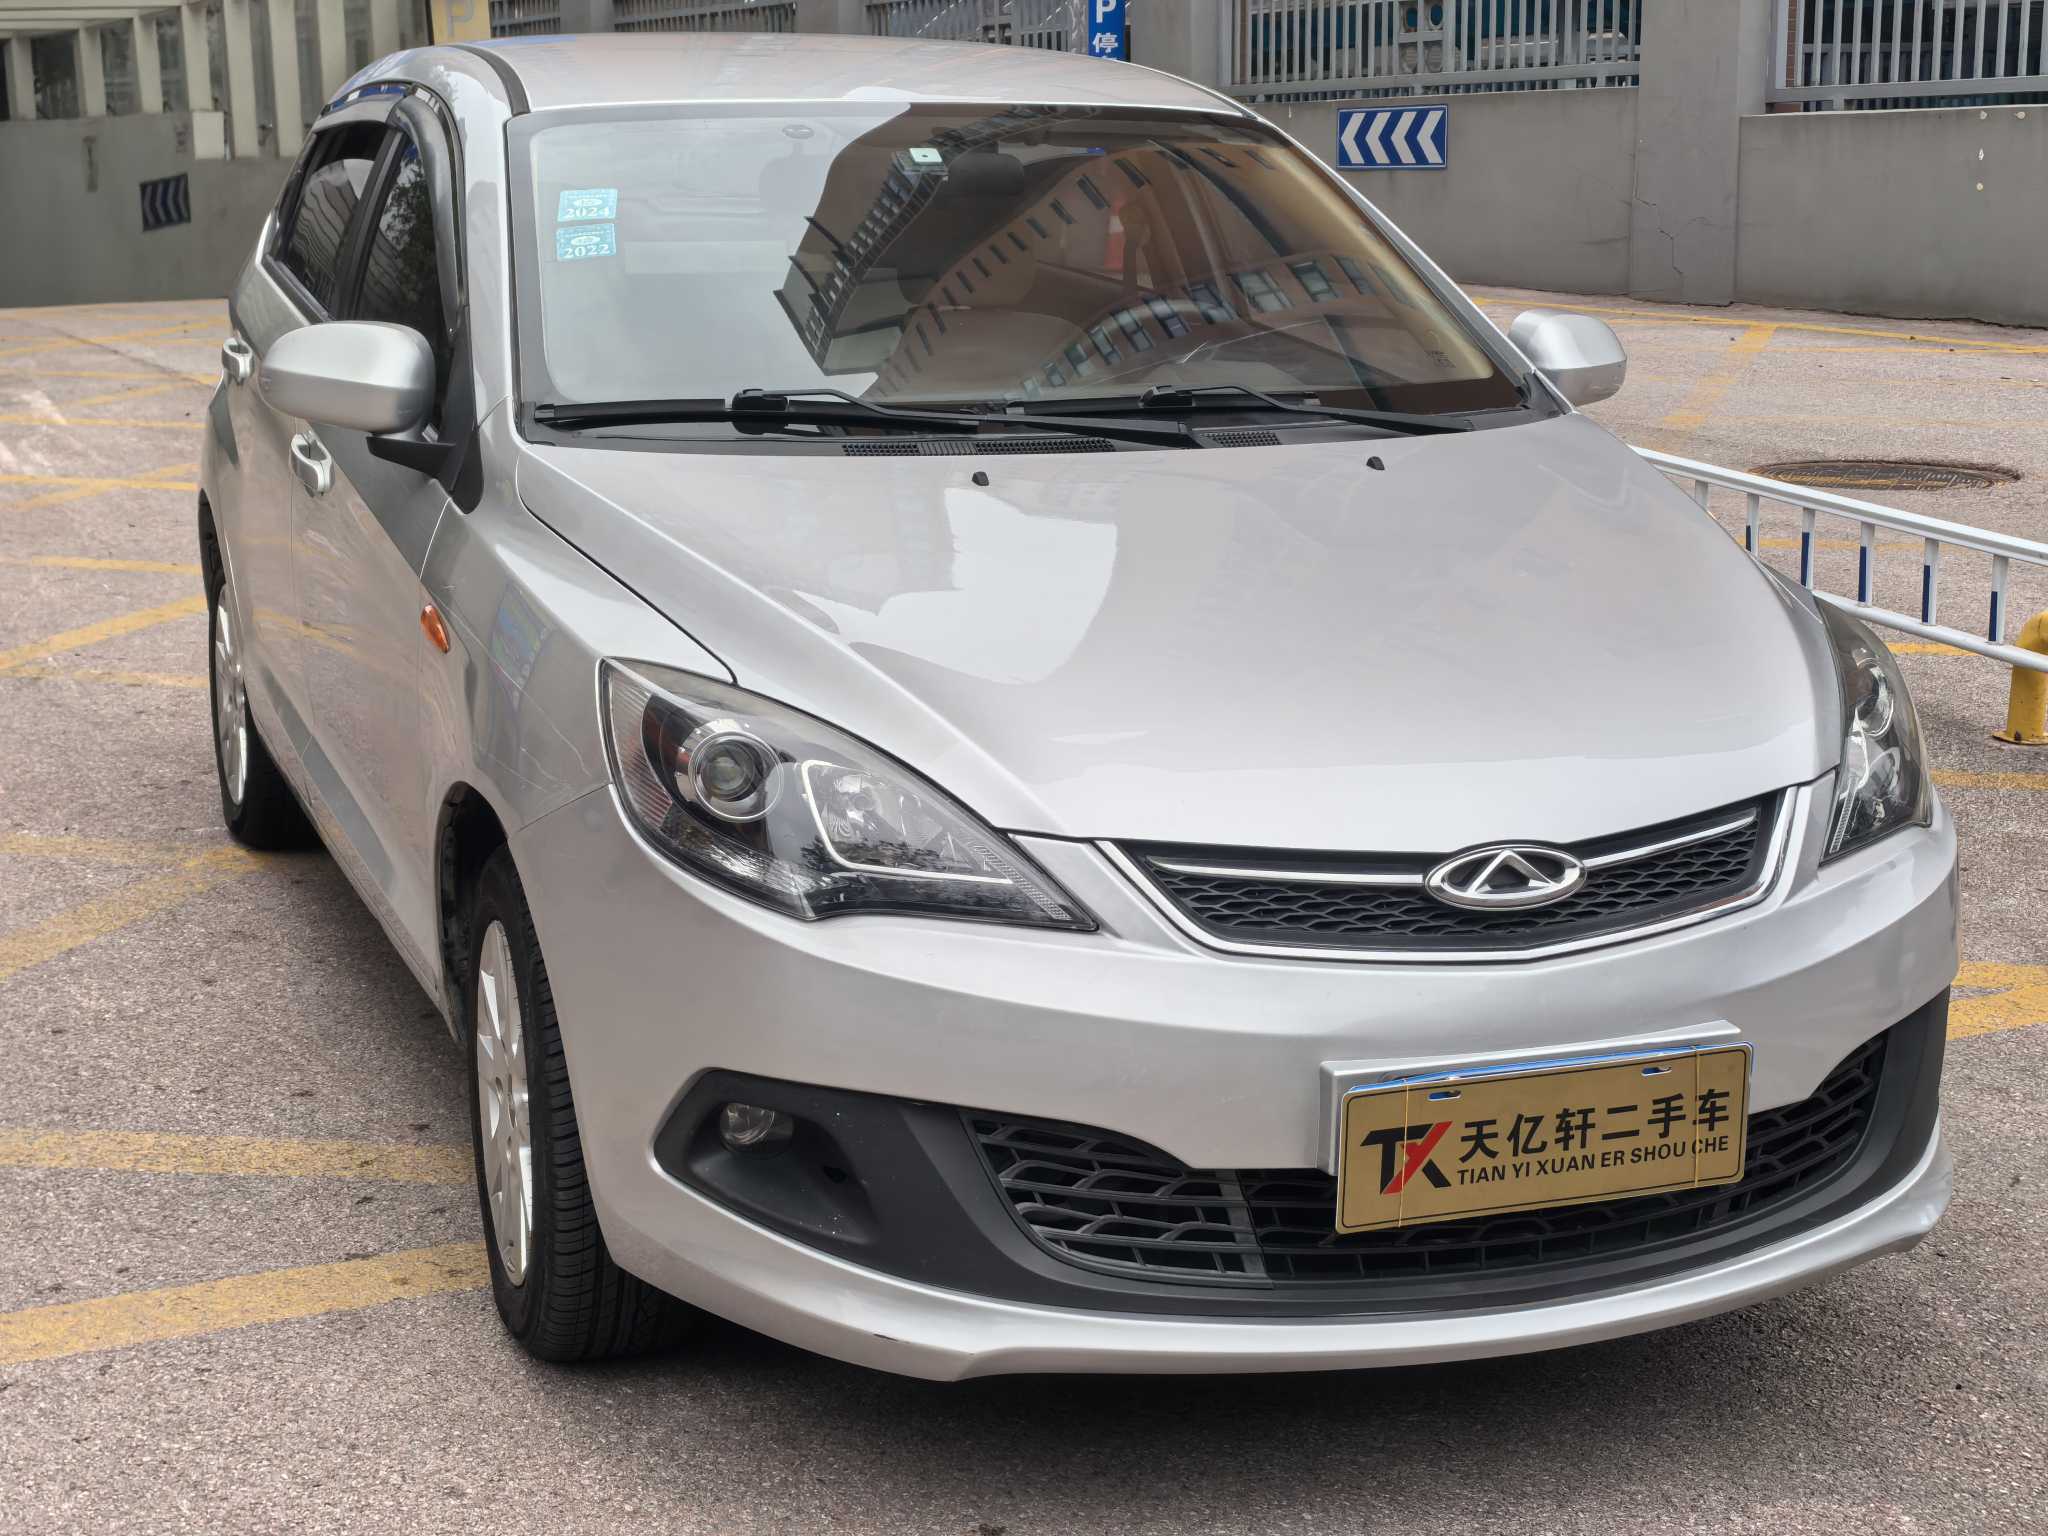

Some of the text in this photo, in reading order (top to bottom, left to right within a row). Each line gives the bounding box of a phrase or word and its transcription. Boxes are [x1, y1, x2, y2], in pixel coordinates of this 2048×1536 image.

[1096, 0, 1116, 23] P
[1092, 32, 1118, 59] 停
[563, 244, 610, 259] 2022
[1458, 1088, 1731, 1163] 天亿轩二手车
[1457, 1135, 1731, 1186] TIAN YI XUAN ER SHOU CHE
